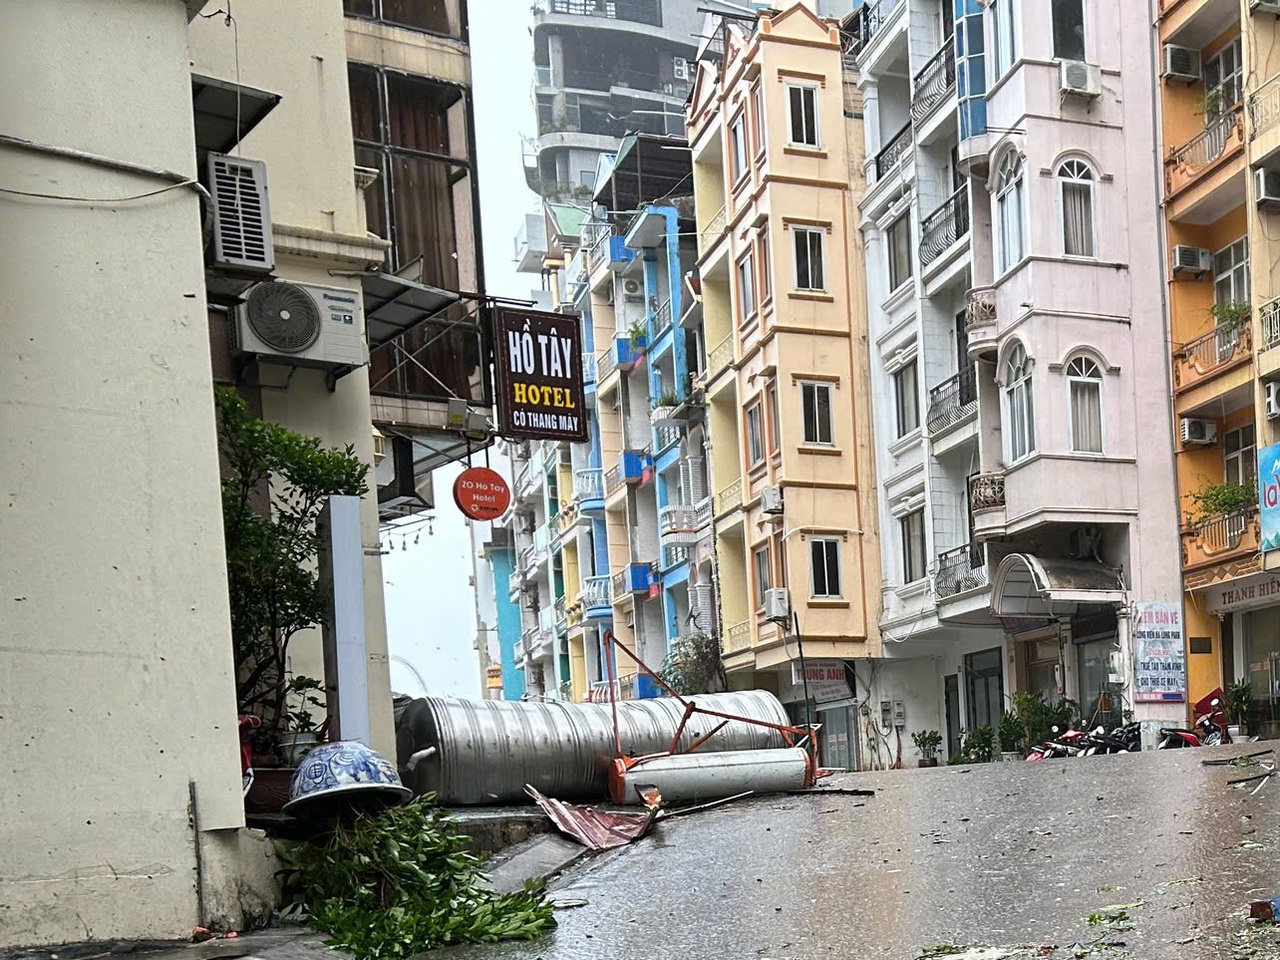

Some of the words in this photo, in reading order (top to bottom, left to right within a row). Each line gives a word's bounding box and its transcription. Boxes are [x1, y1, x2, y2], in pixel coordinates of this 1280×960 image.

[508, 318, 535, 375] HỒ
[537, 327, 572, 379] TÂY
[513, 382, 576, 409] HOTEL
[527, 412, 557, 430] THANG
[1221, 585, 1255, 605] THANH
[827, 669, 845, 680] ANH
